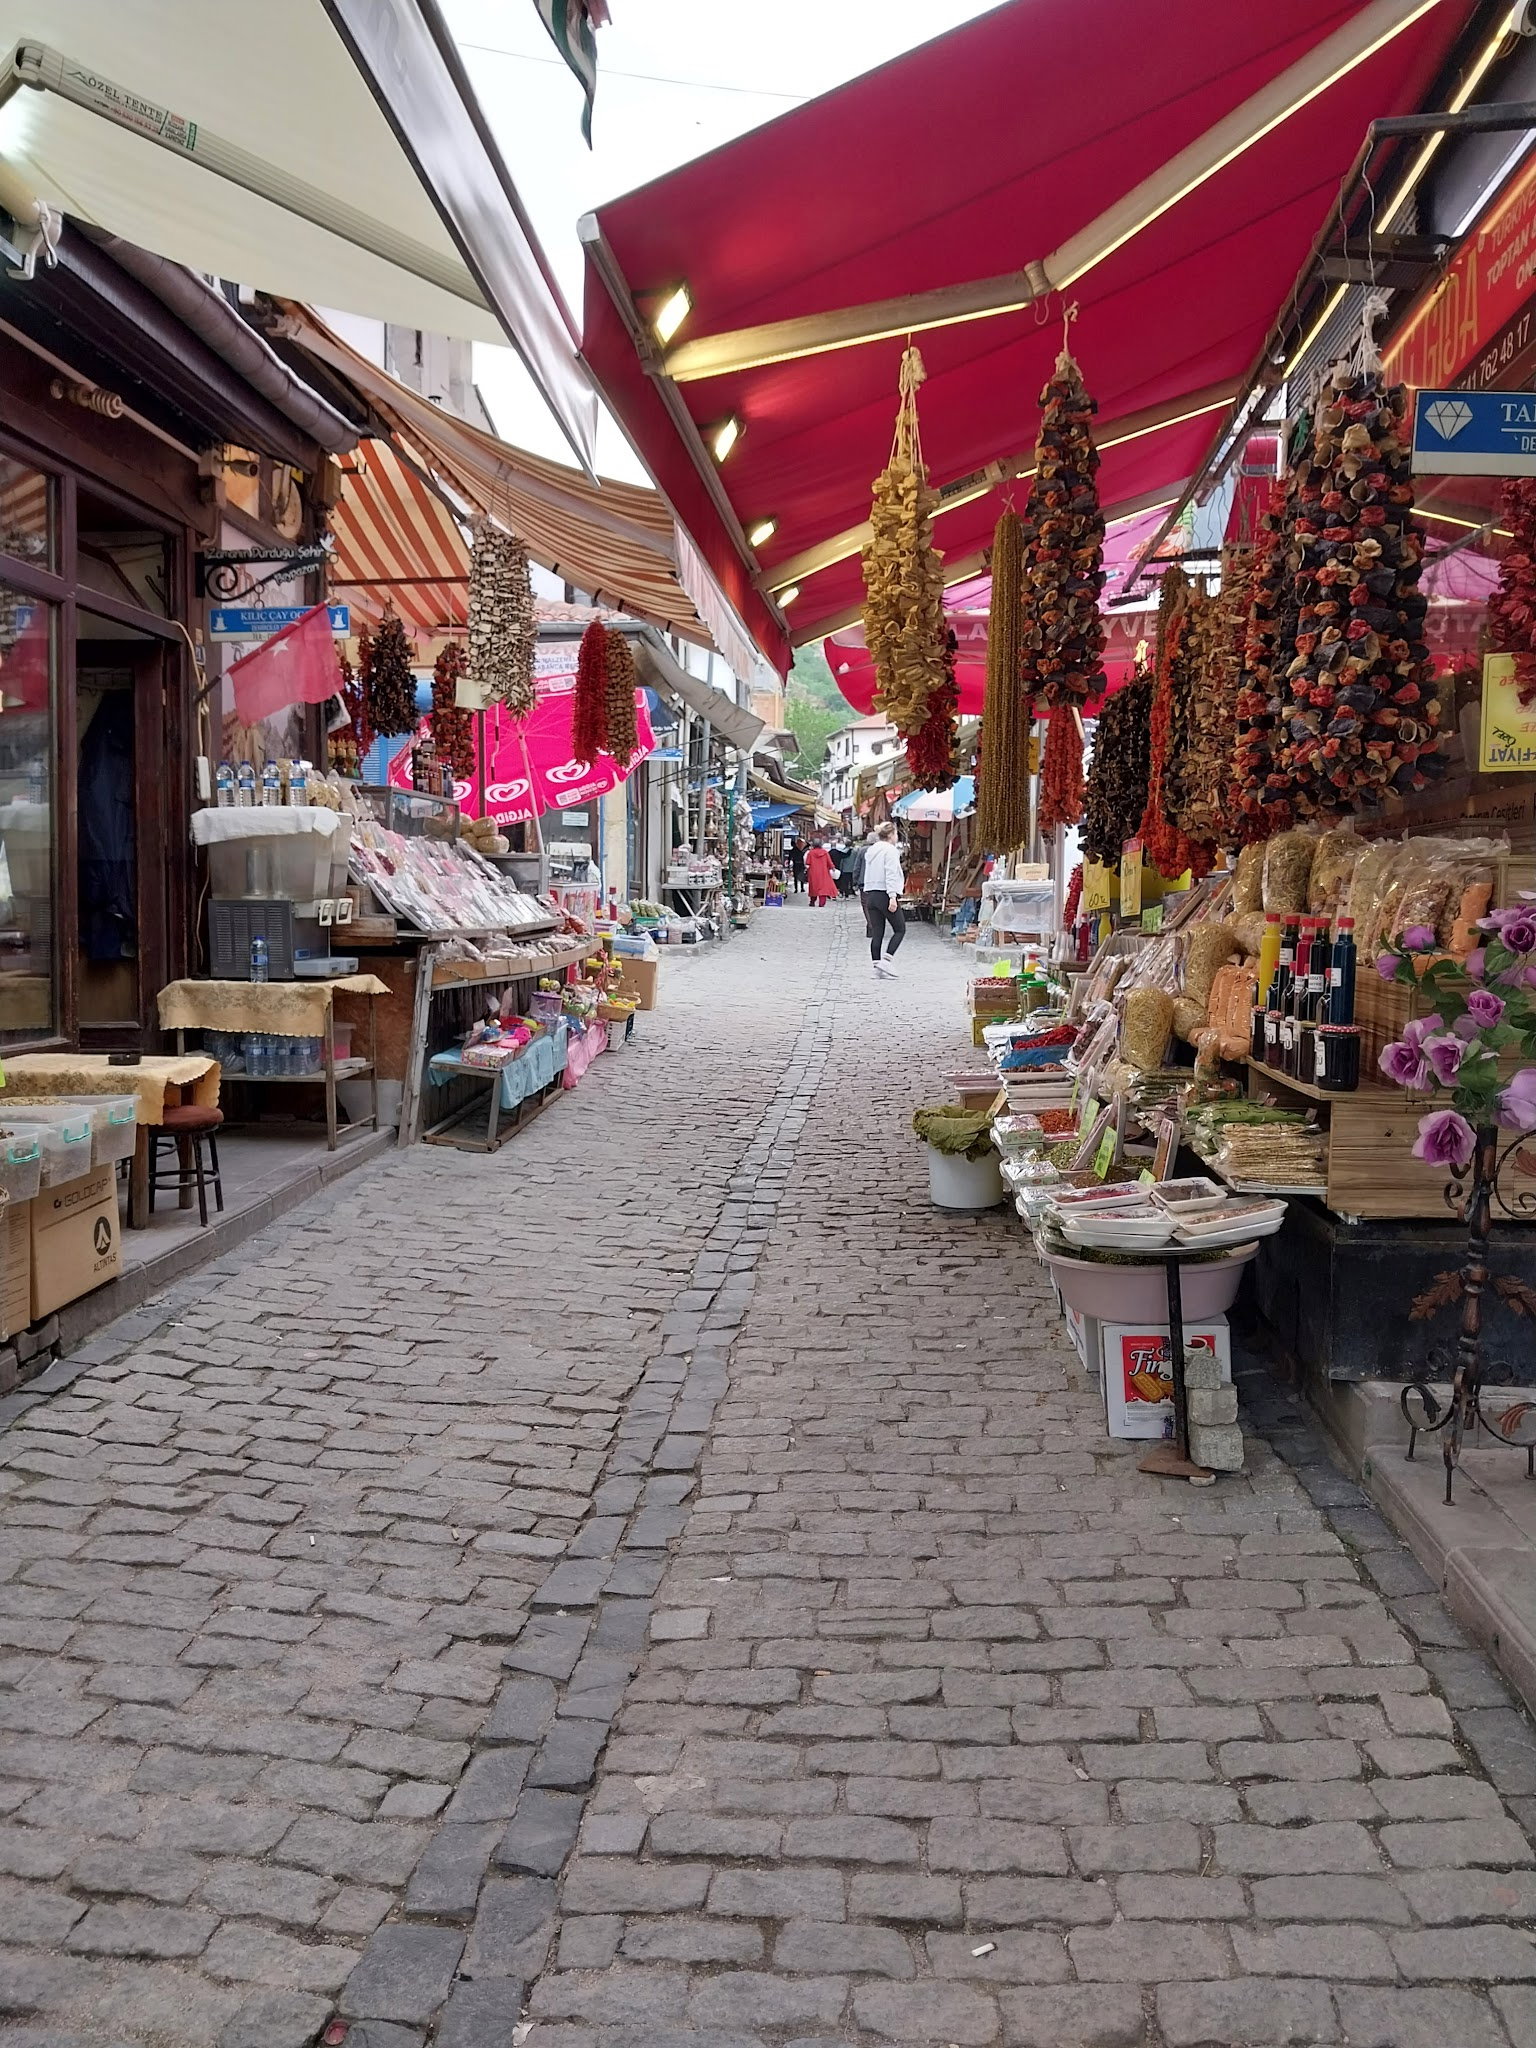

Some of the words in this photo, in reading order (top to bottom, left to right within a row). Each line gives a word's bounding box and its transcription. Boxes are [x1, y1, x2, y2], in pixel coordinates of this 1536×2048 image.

[88, 76, 120, 100] ÖZEL
[124, 94, 164, 122] TENTE
[1480, 348, 1498, 387] 762
[1500, 331, 1514, 364] 48
[1517, 311, 1531, 348] 17
[298, 545, 324, 560] Şehir
[269, 611, 289, 622] ÇAY
[1489, 747, 1531, 764] FİYAT
